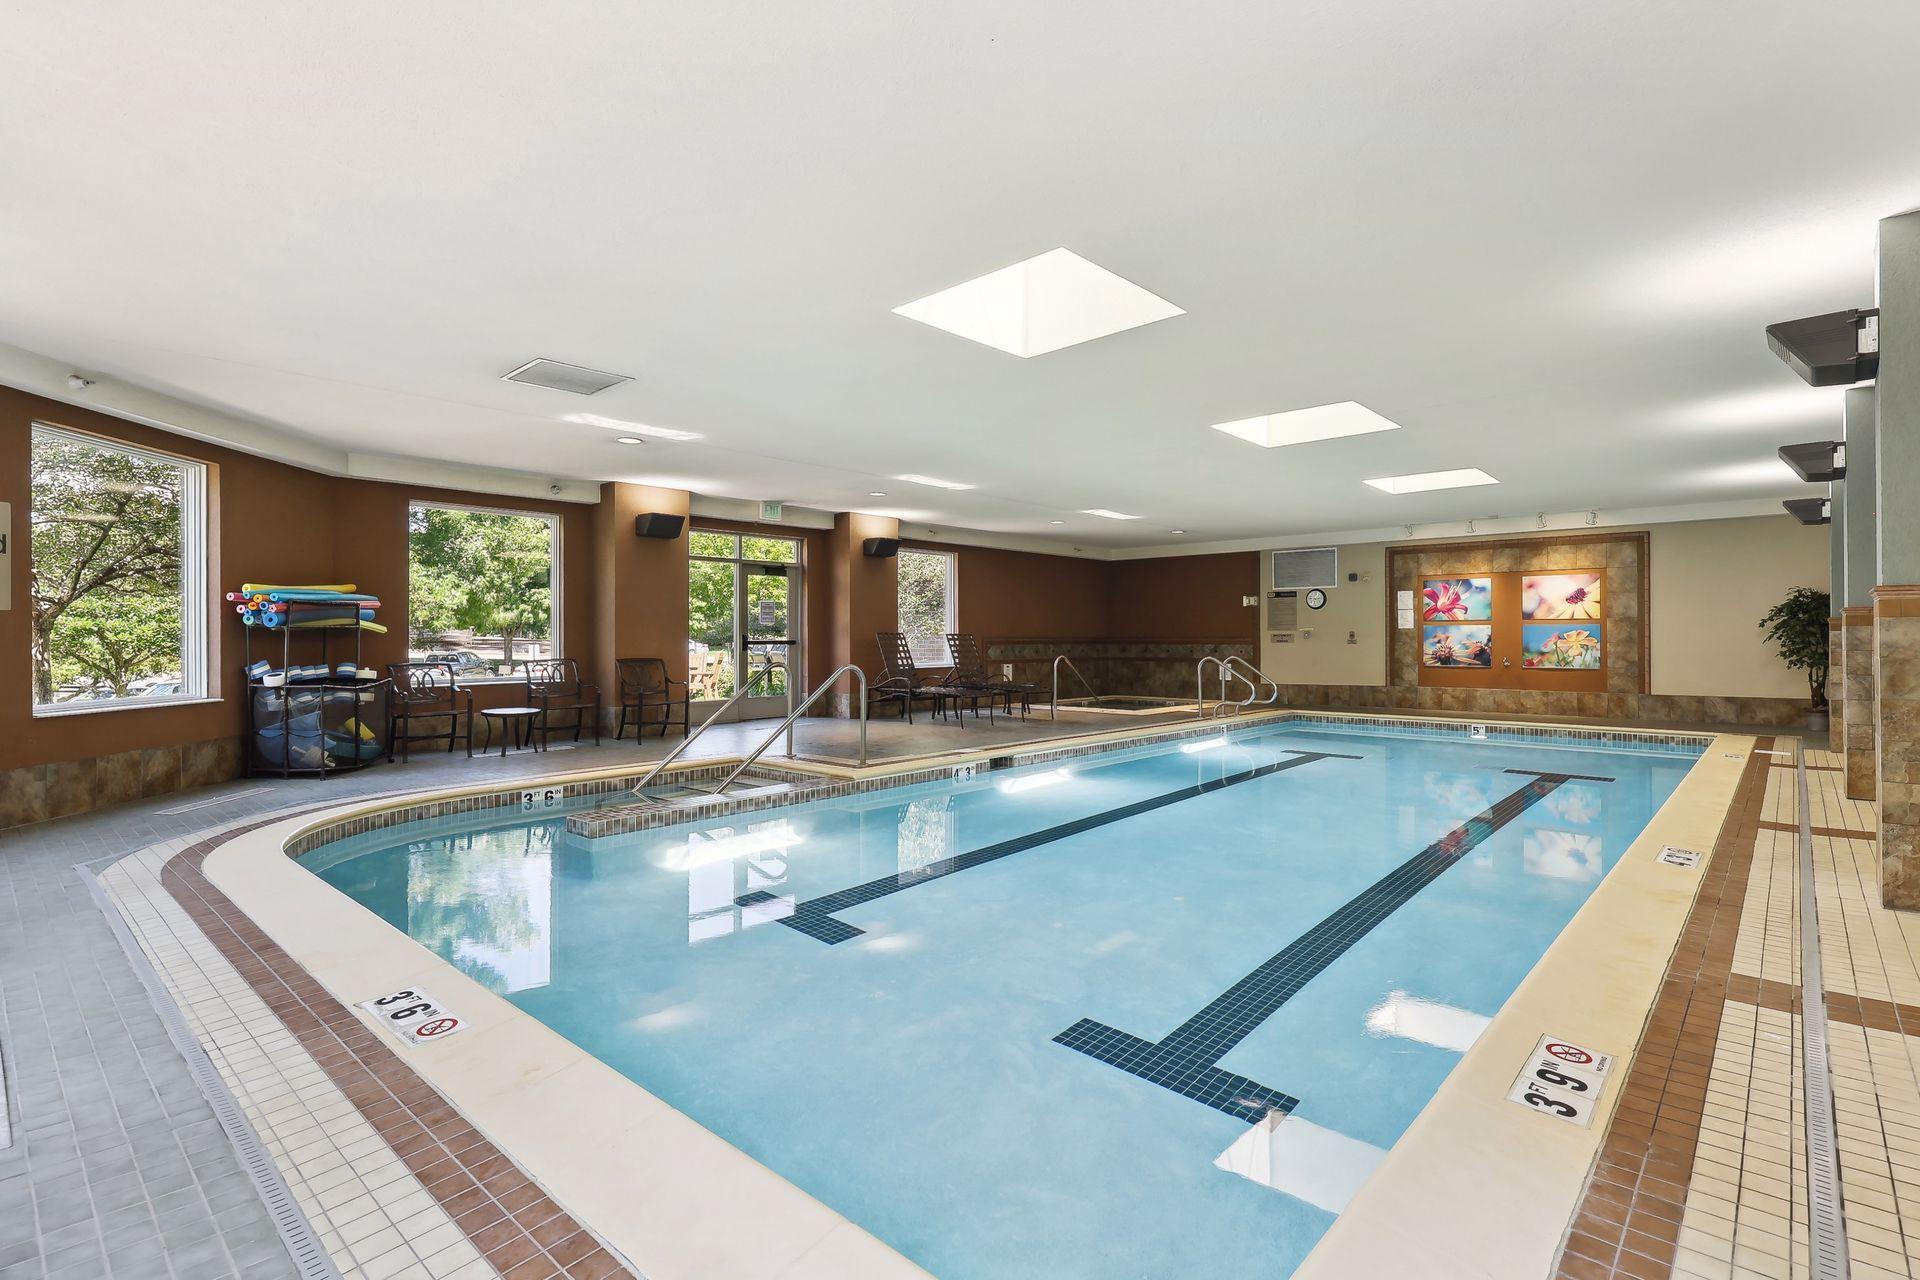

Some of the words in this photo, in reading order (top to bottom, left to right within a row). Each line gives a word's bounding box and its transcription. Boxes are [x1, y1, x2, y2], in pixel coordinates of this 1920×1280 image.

[375, 990, 415, 1006] 3
[406, 995, 422, 1003] FT
[390, 1003, 432, 1020] 6
[422, 1008, 440, 1018] IN
[1540, 1059, 1560, 1072] IN
[1536, 1068, 1588, 1092] 9
[1528, 1081, 1549, 1096] FT
[1523, 1092, 1578, 1118] 3
